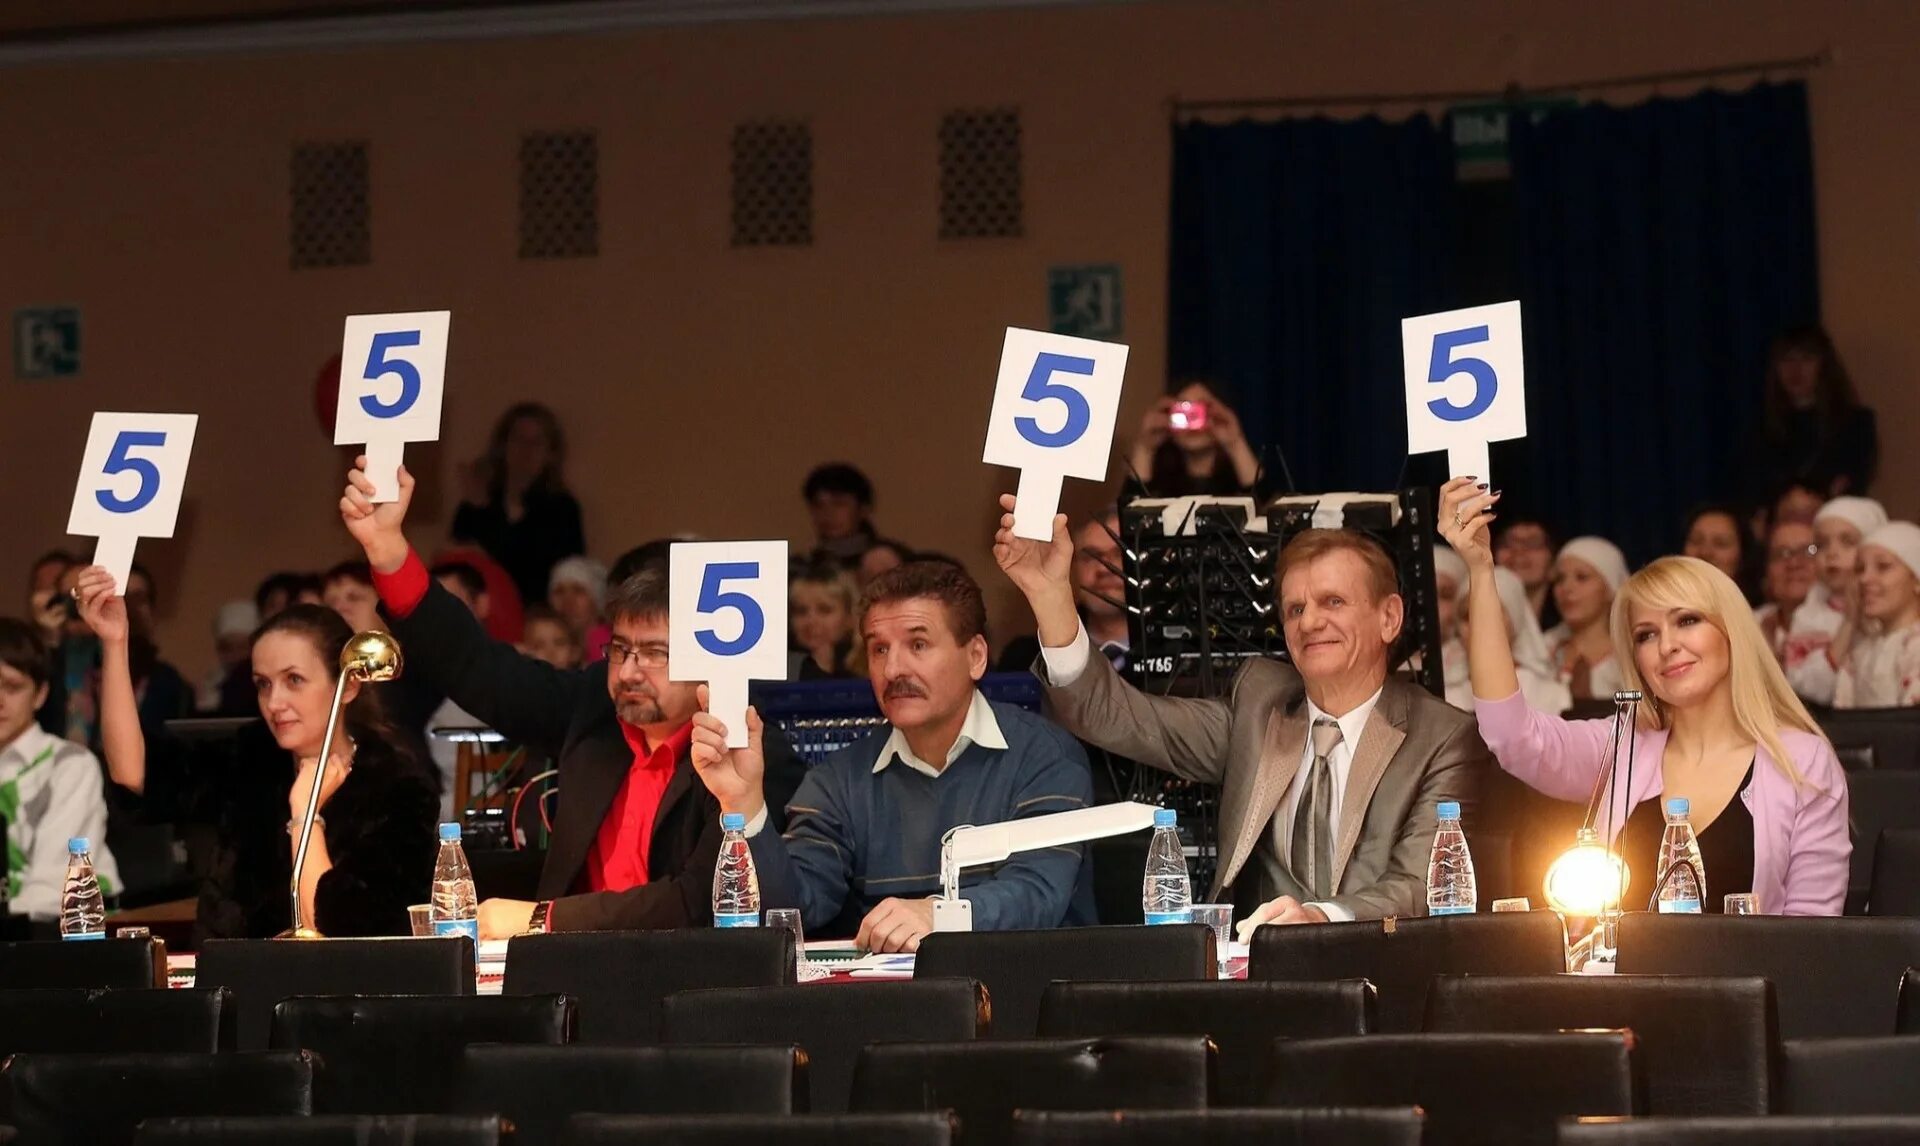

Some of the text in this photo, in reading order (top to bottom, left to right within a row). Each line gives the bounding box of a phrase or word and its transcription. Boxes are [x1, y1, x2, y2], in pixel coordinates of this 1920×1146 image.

[359, 330, 421, 419] 5
[1014, 351, 1095, 447] 5
[1427, 324, 1498, 421] 5
[96, 430, 166, 513] 5
[694, 562, 765, 656] 5
